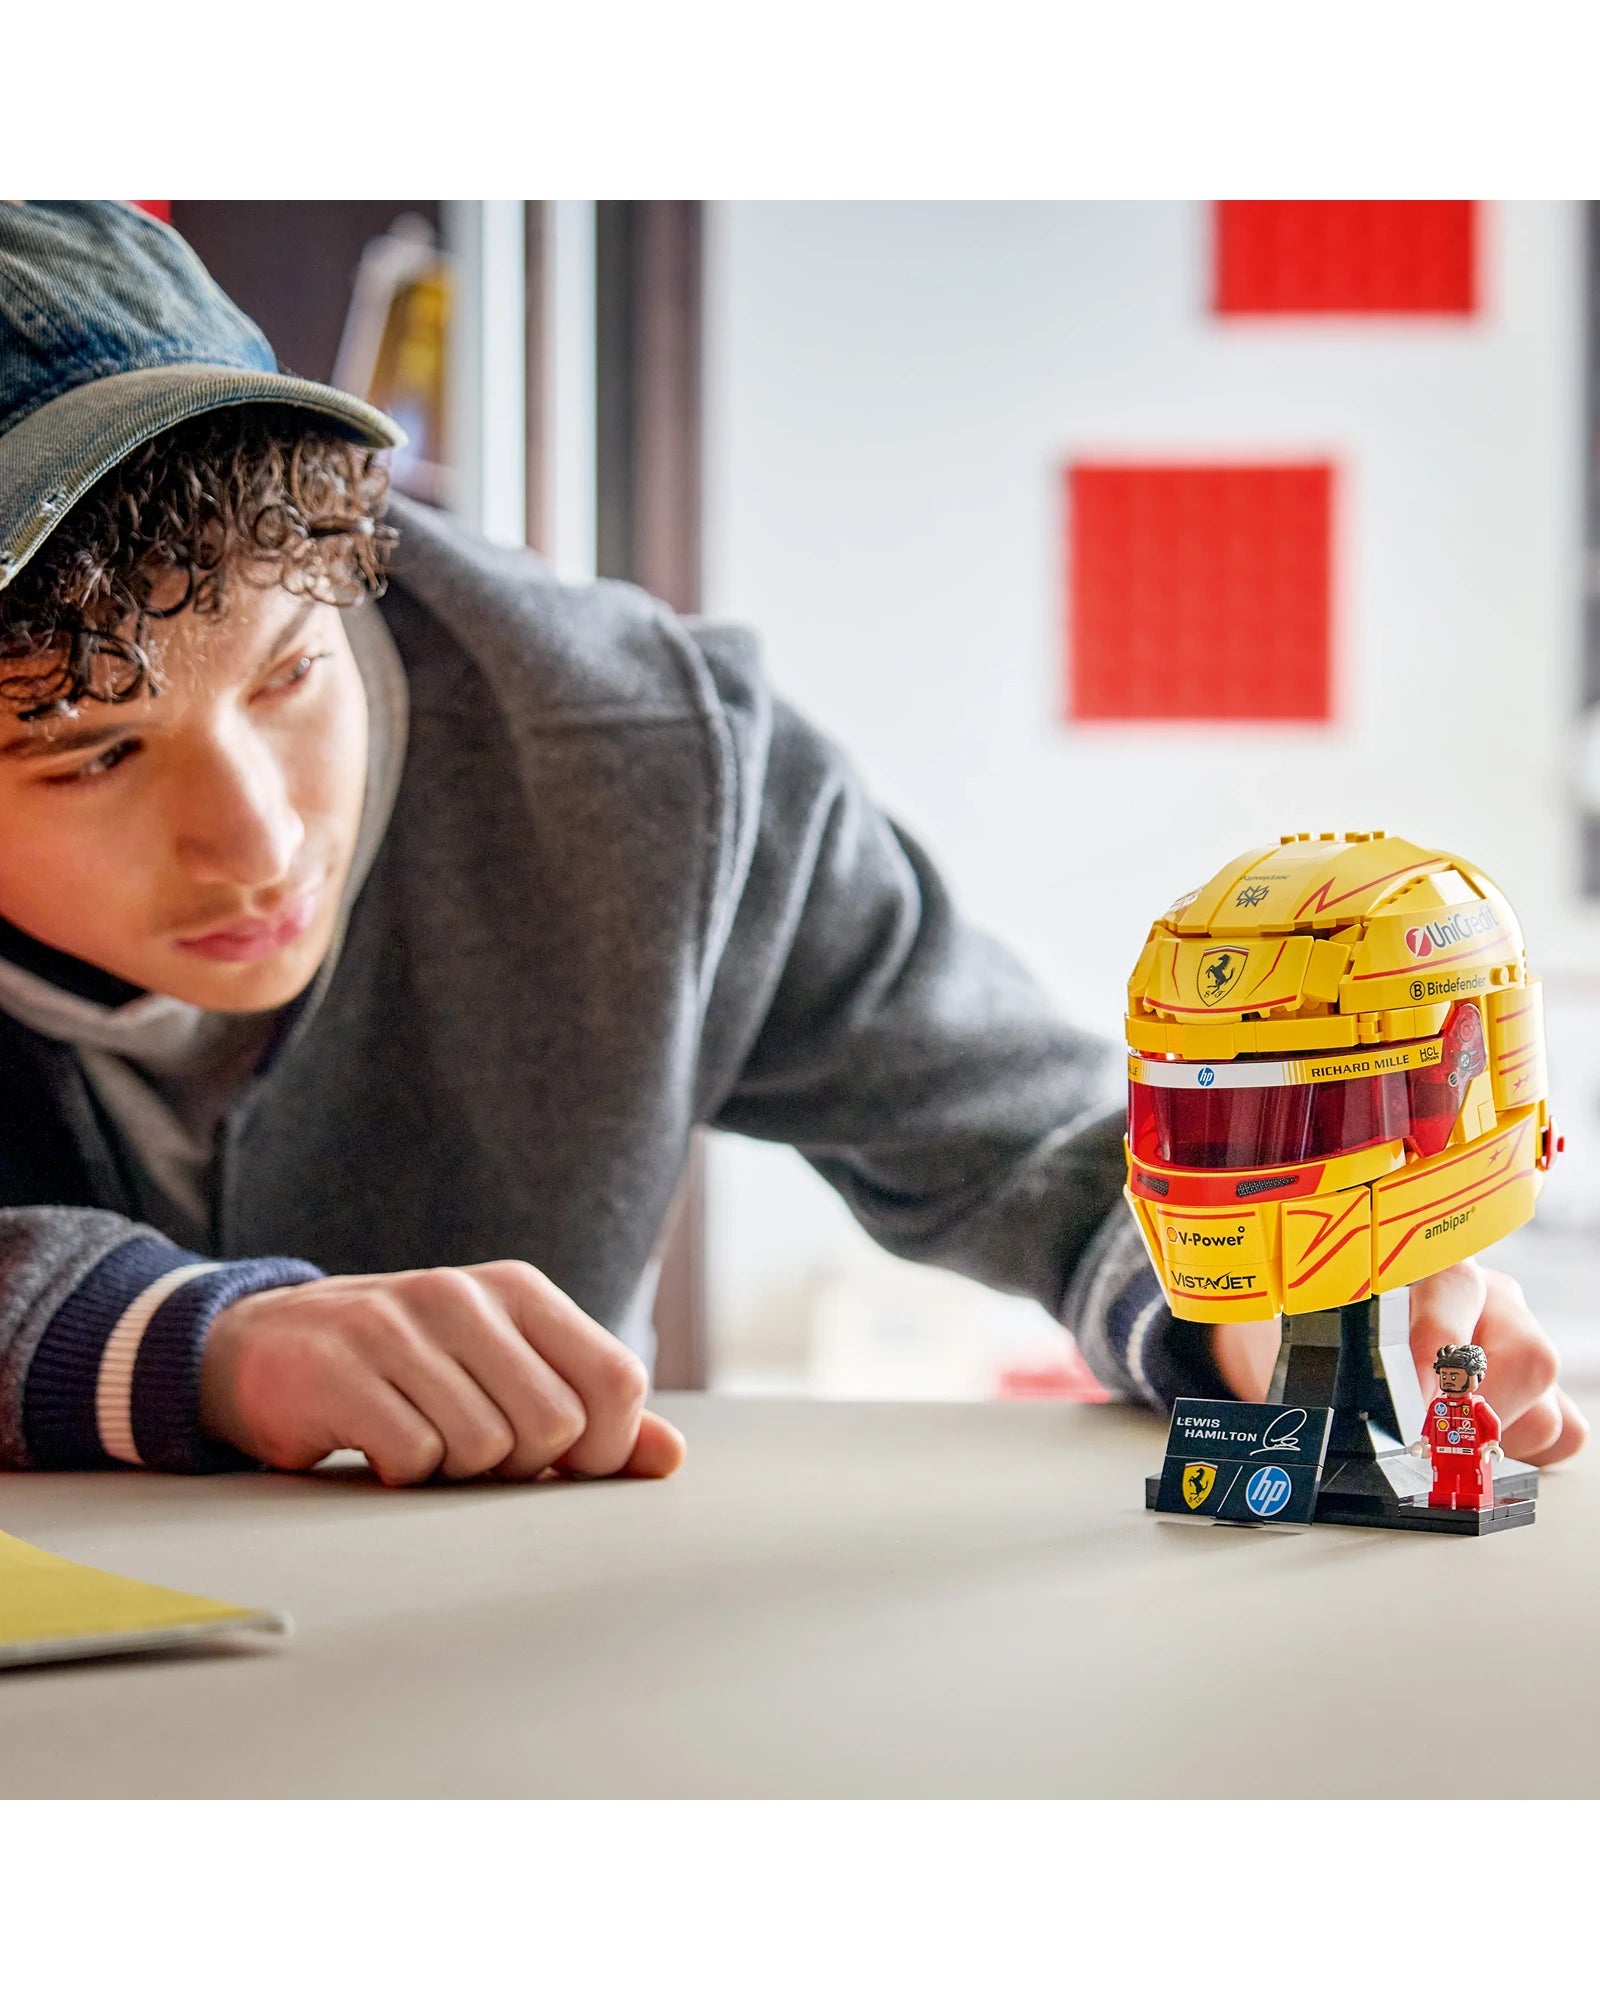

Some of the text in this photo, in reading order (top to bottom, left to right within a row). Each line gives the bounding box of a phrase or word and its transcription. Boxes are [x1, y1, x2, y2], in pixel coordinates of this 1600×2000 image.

[1426, 903, 1499, 948] UniCredit
[1427, 975, 1487, 995] Bitdefender
[1419, 1045, 1439, 1058] HCL
[1311, 1054, 1410, 1077] RICHARD MILLE
[1199, 1067, 1214, 1086] hp
[1425, 1210, 1470, 1239] ambipar
[1178, 1231, 1244, 1246] V-Power
[1176, 1417, 1221, 1428] LEWIS
[1184, 1429, 1258, 1442] HAMILTON
[1250, 1466, 1288, 1516] hp
